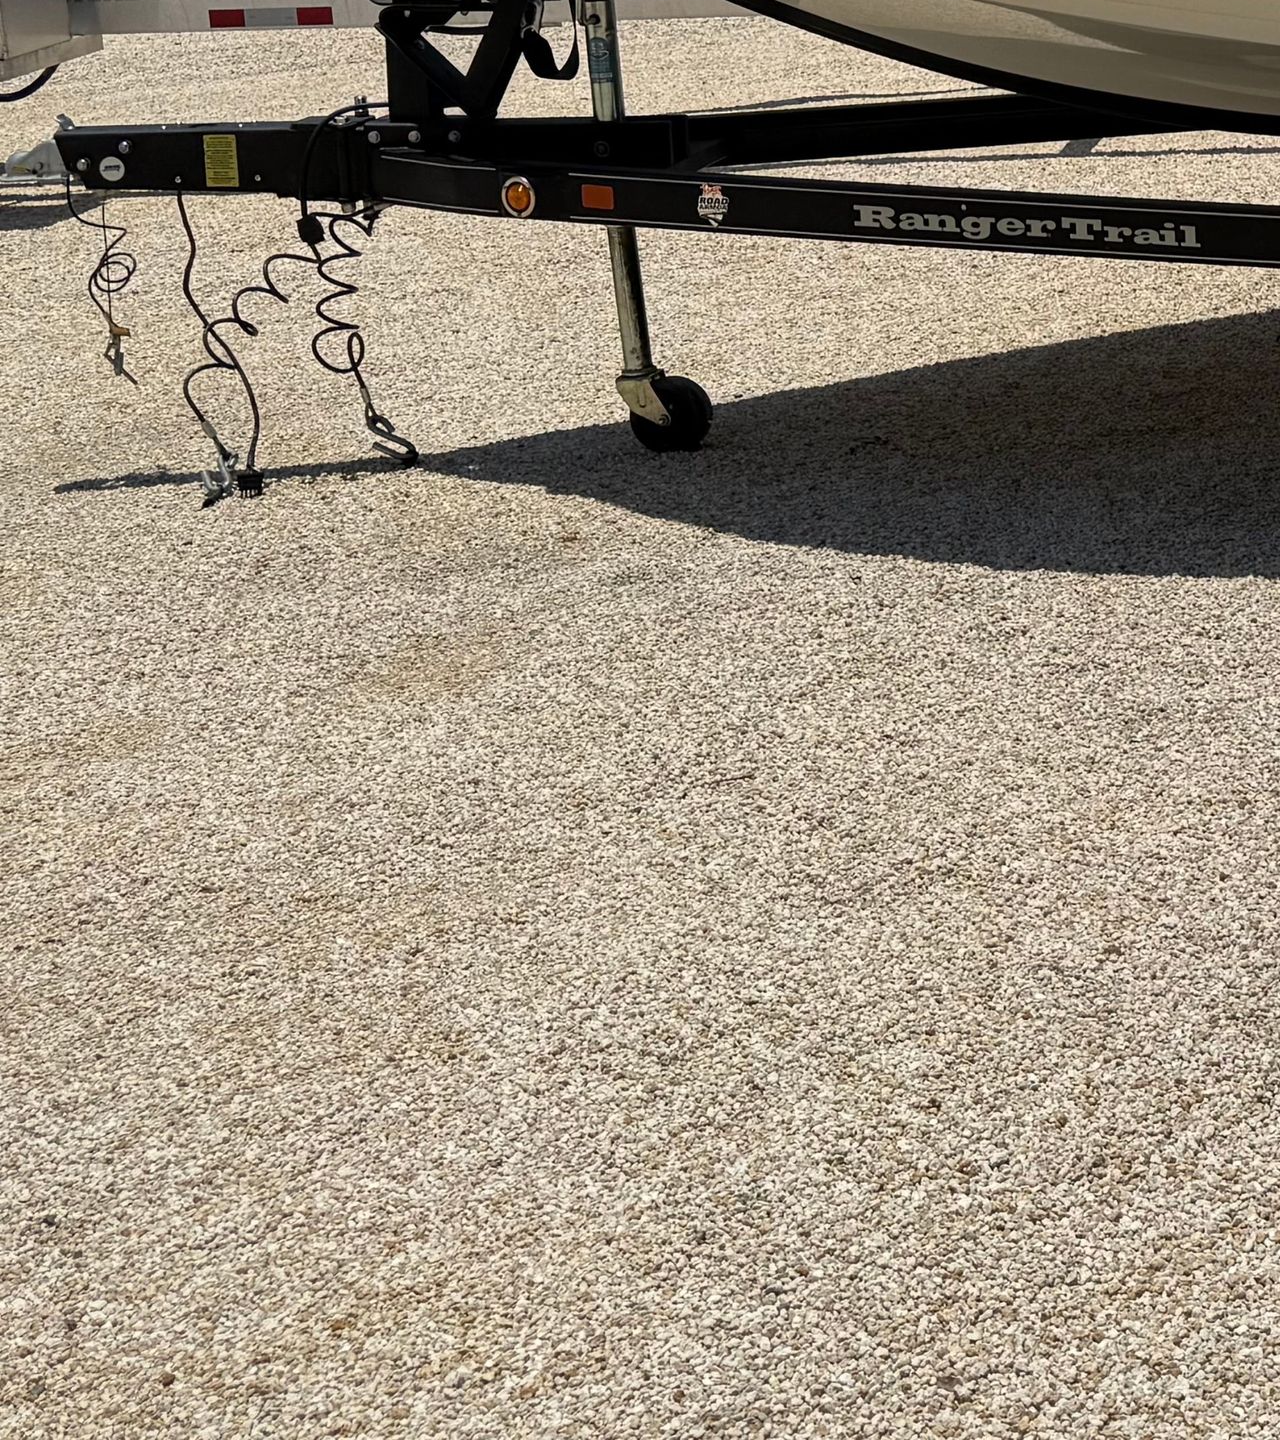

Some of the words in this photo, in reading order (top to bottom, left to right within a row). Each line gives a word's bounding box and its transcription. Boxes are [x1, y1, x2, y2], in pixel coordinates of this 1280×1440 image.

[699, 197, 729, 205] ROAD
[853, 204, 1056, 240] Ranger
[1061, 217, 1201, 248] Trail
